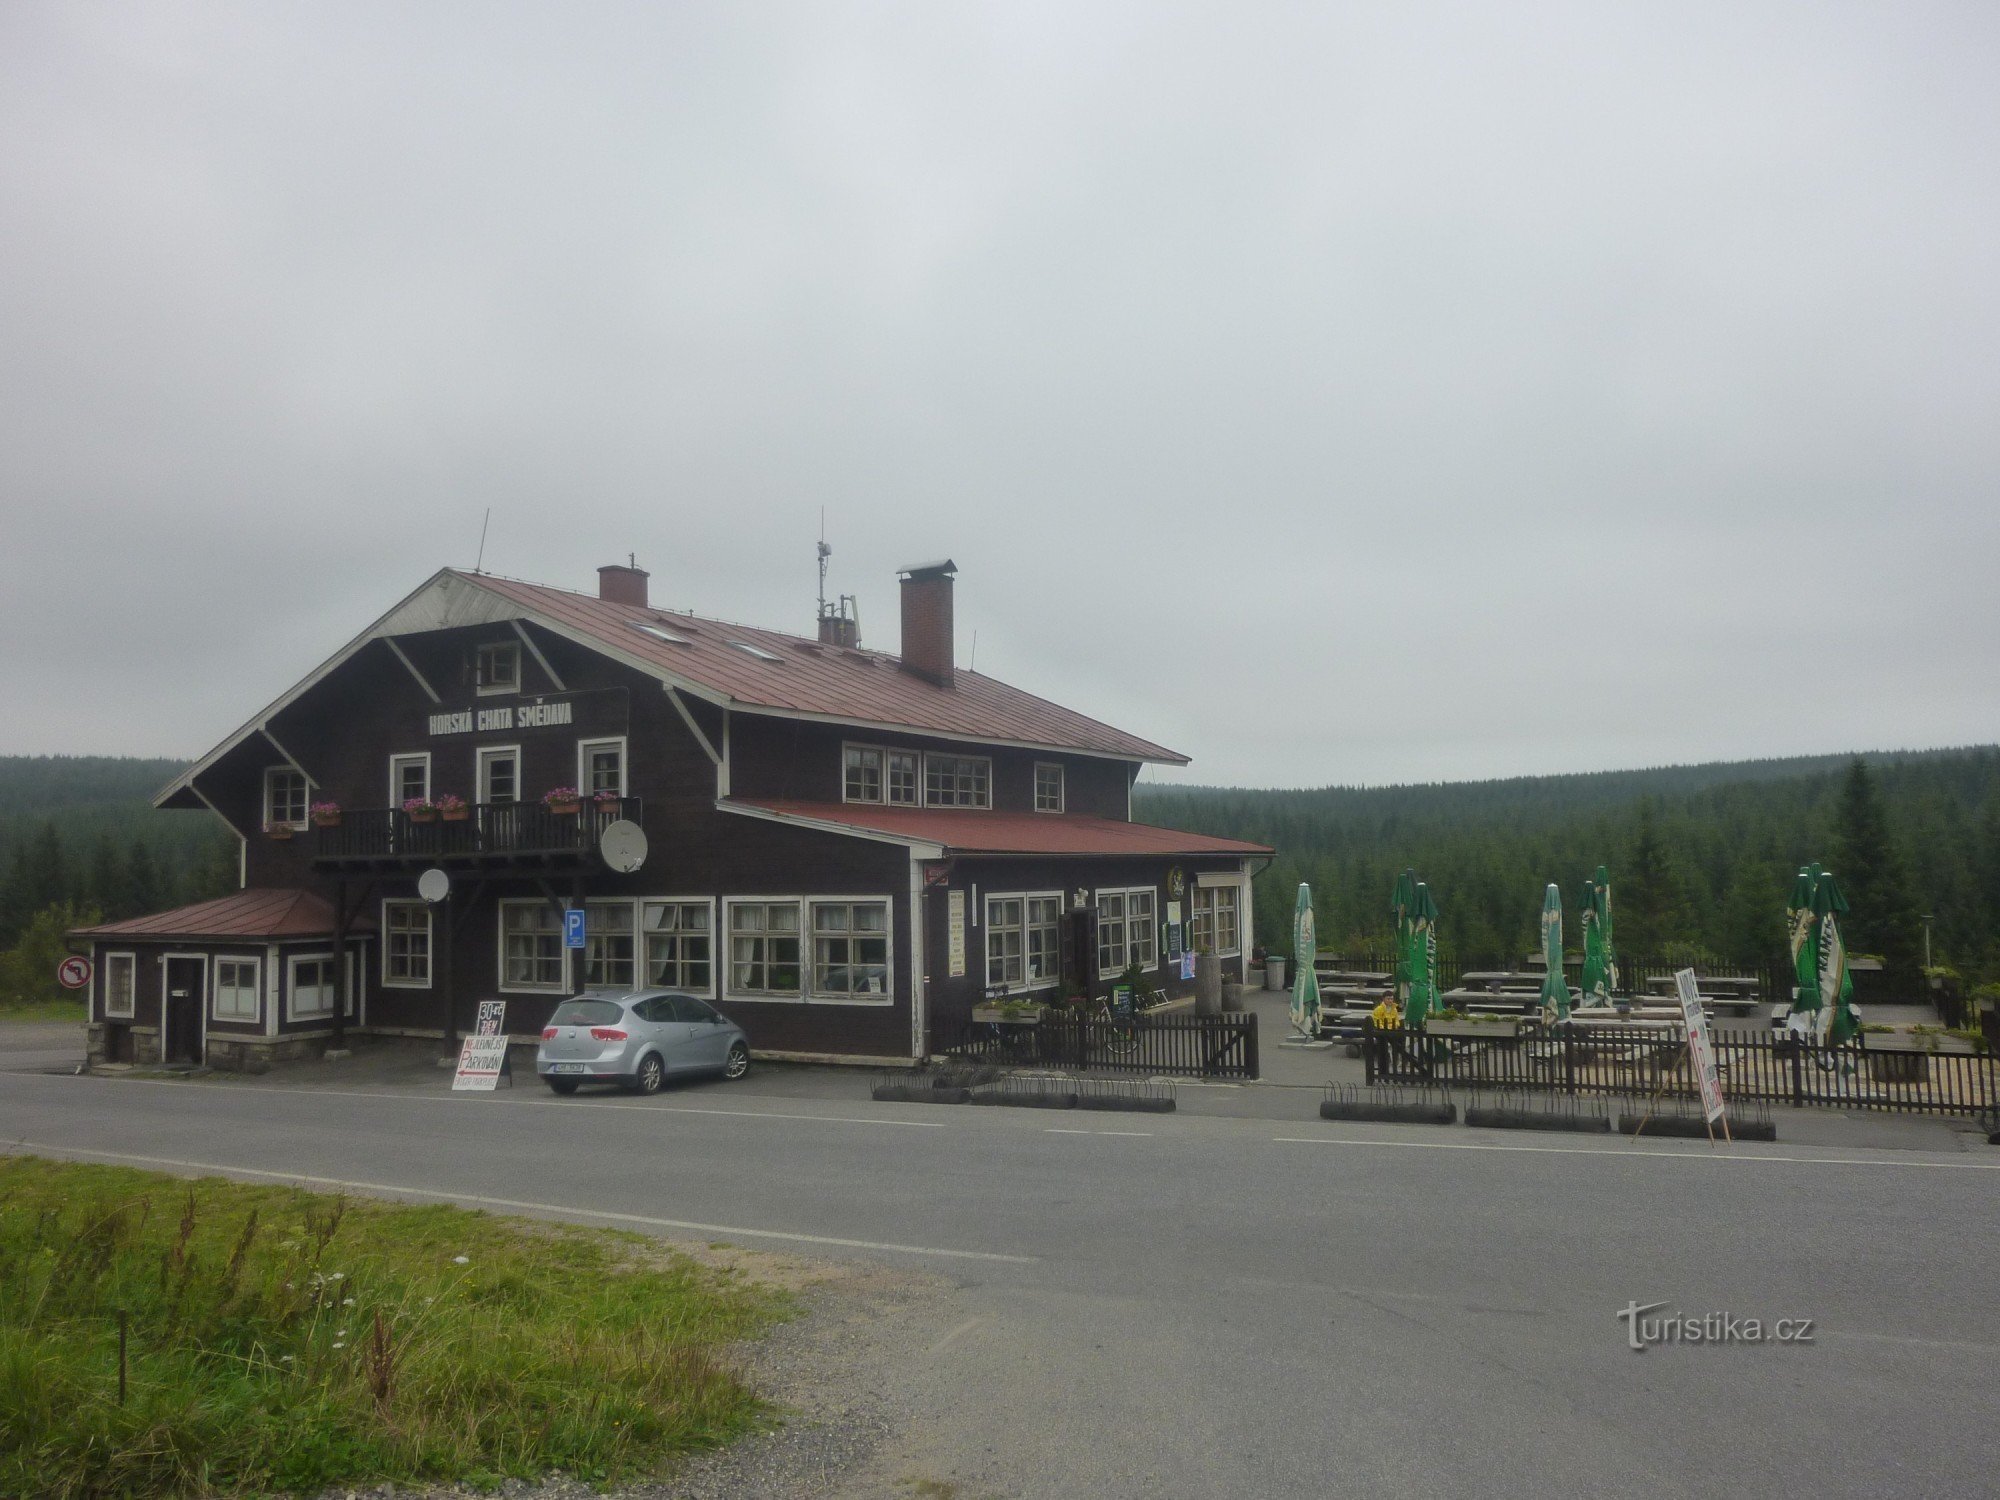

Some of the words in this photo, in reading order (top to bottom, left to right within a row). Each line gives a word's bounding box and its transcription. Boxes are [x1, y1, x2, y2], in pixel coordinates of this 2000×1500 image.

[430, 708, 473, 735] HORSKÁ
[478, 708, 513, 730] CHATA
[518, 698, 572, 727] SMĚDAVA
[569, 914, 581, 937] P
[481, 1020, 498, 1029] DEN
